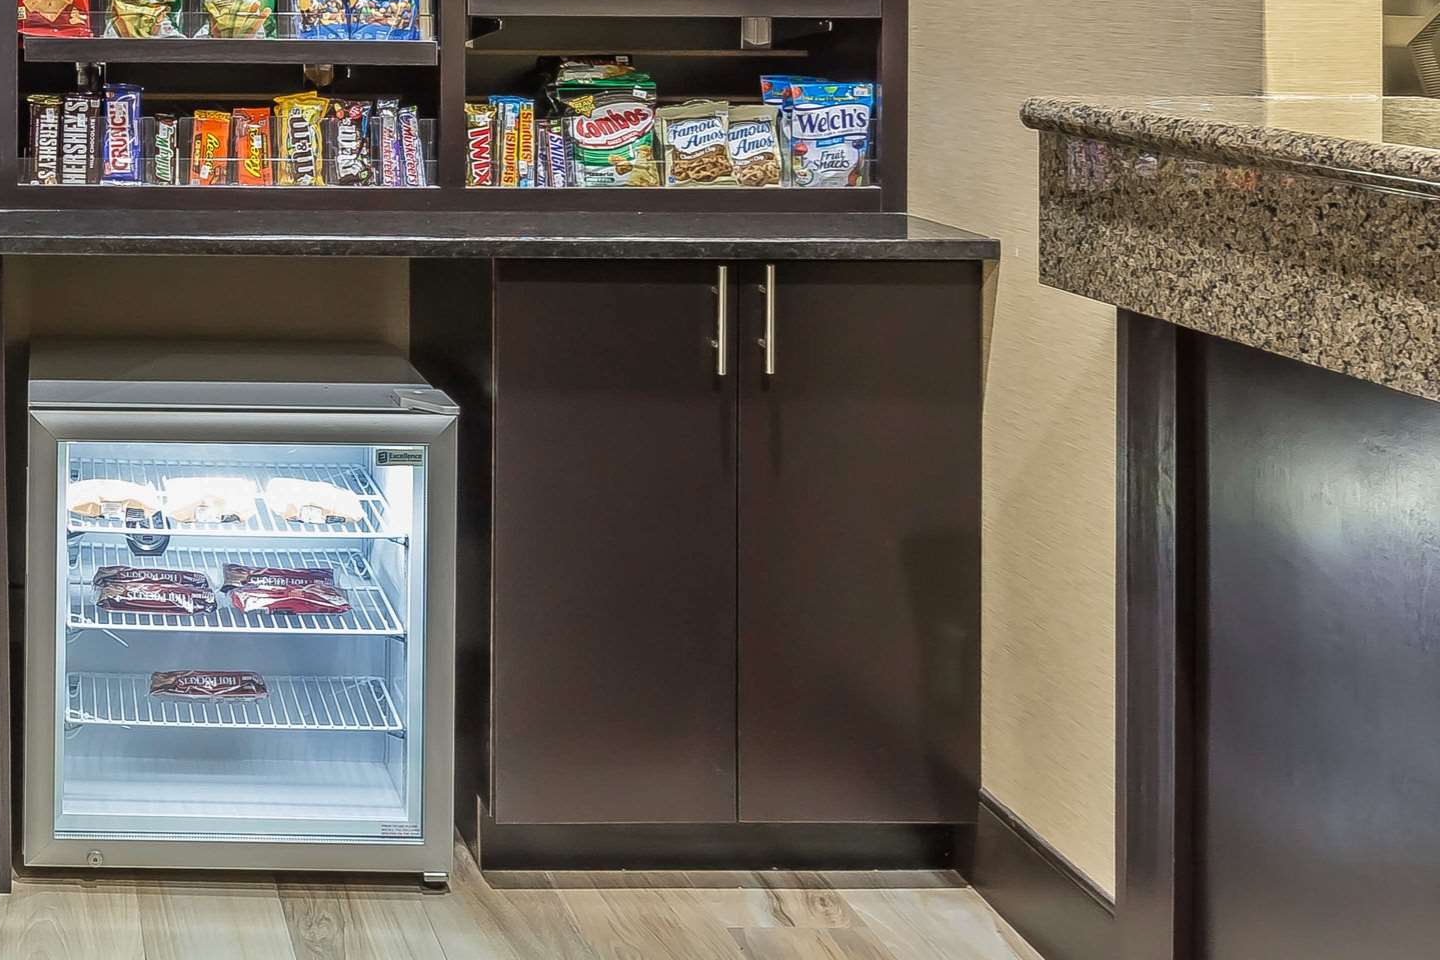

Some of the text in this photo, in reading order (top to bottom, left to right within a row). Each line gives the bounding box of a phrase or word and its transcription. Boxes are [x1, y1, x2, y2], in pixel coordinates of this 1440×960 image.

[576, 108, 650, 139] Combos
[728, 122, 771, 141] amous
[796, 110, 868, 134] Welch's
[682, 130, 725, 149] Amos
[736, 138, 773, 156] Amos
[468, 126, 492, 185] TWIX
